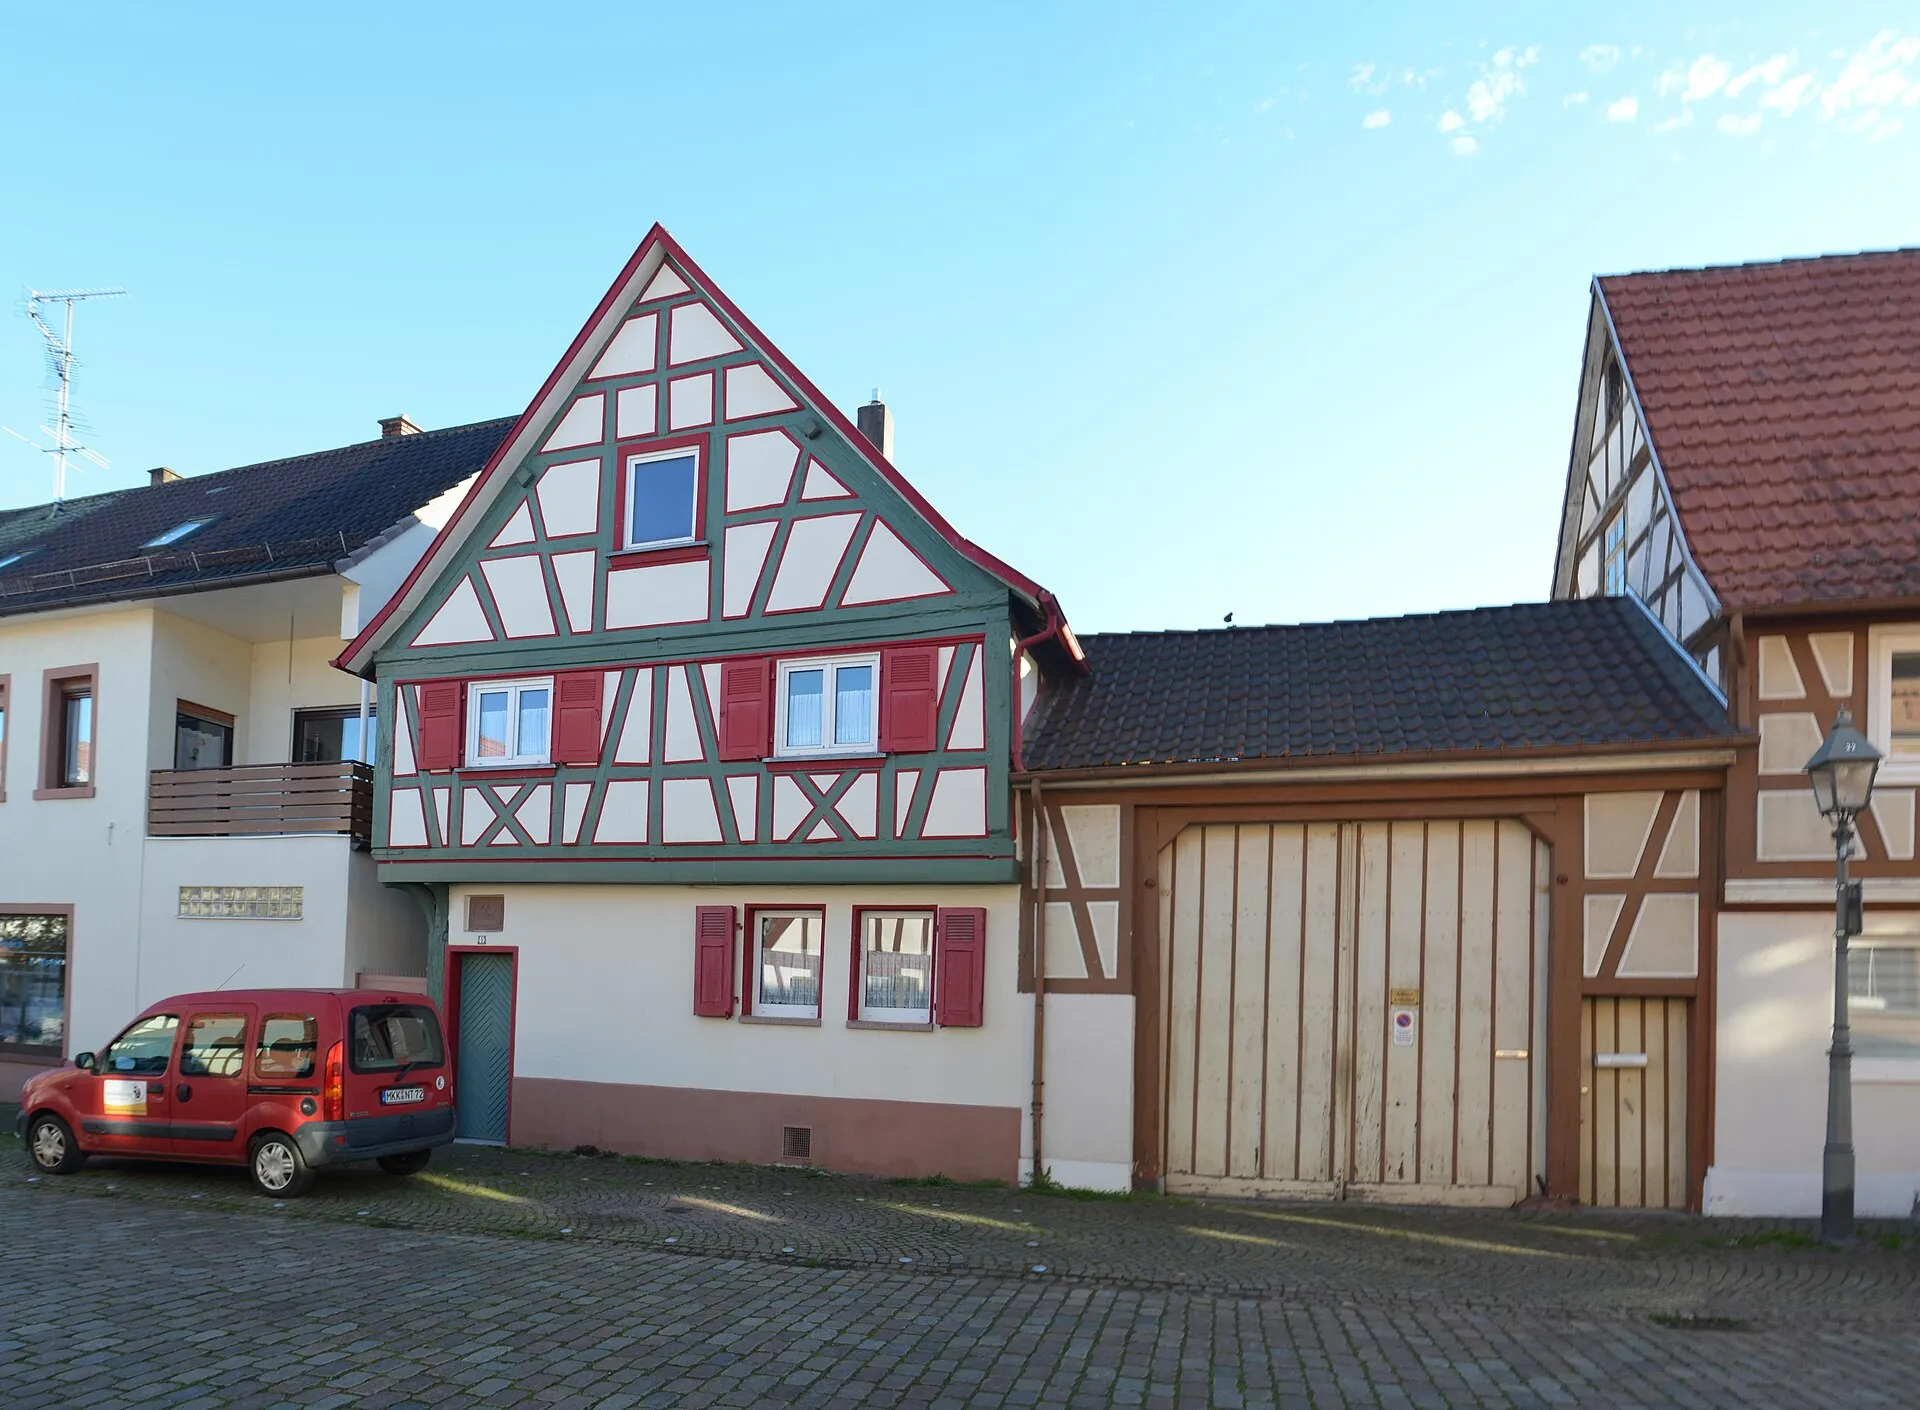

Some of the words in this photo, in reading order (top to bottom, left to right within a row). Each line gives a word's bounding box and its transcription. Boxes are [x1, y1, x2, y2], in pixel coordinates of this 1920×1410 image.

[386, 1090, 401, 1101] MKK
[404, 1089, 414, 1100] NT
[415, 1088, 424, 1099] 72
